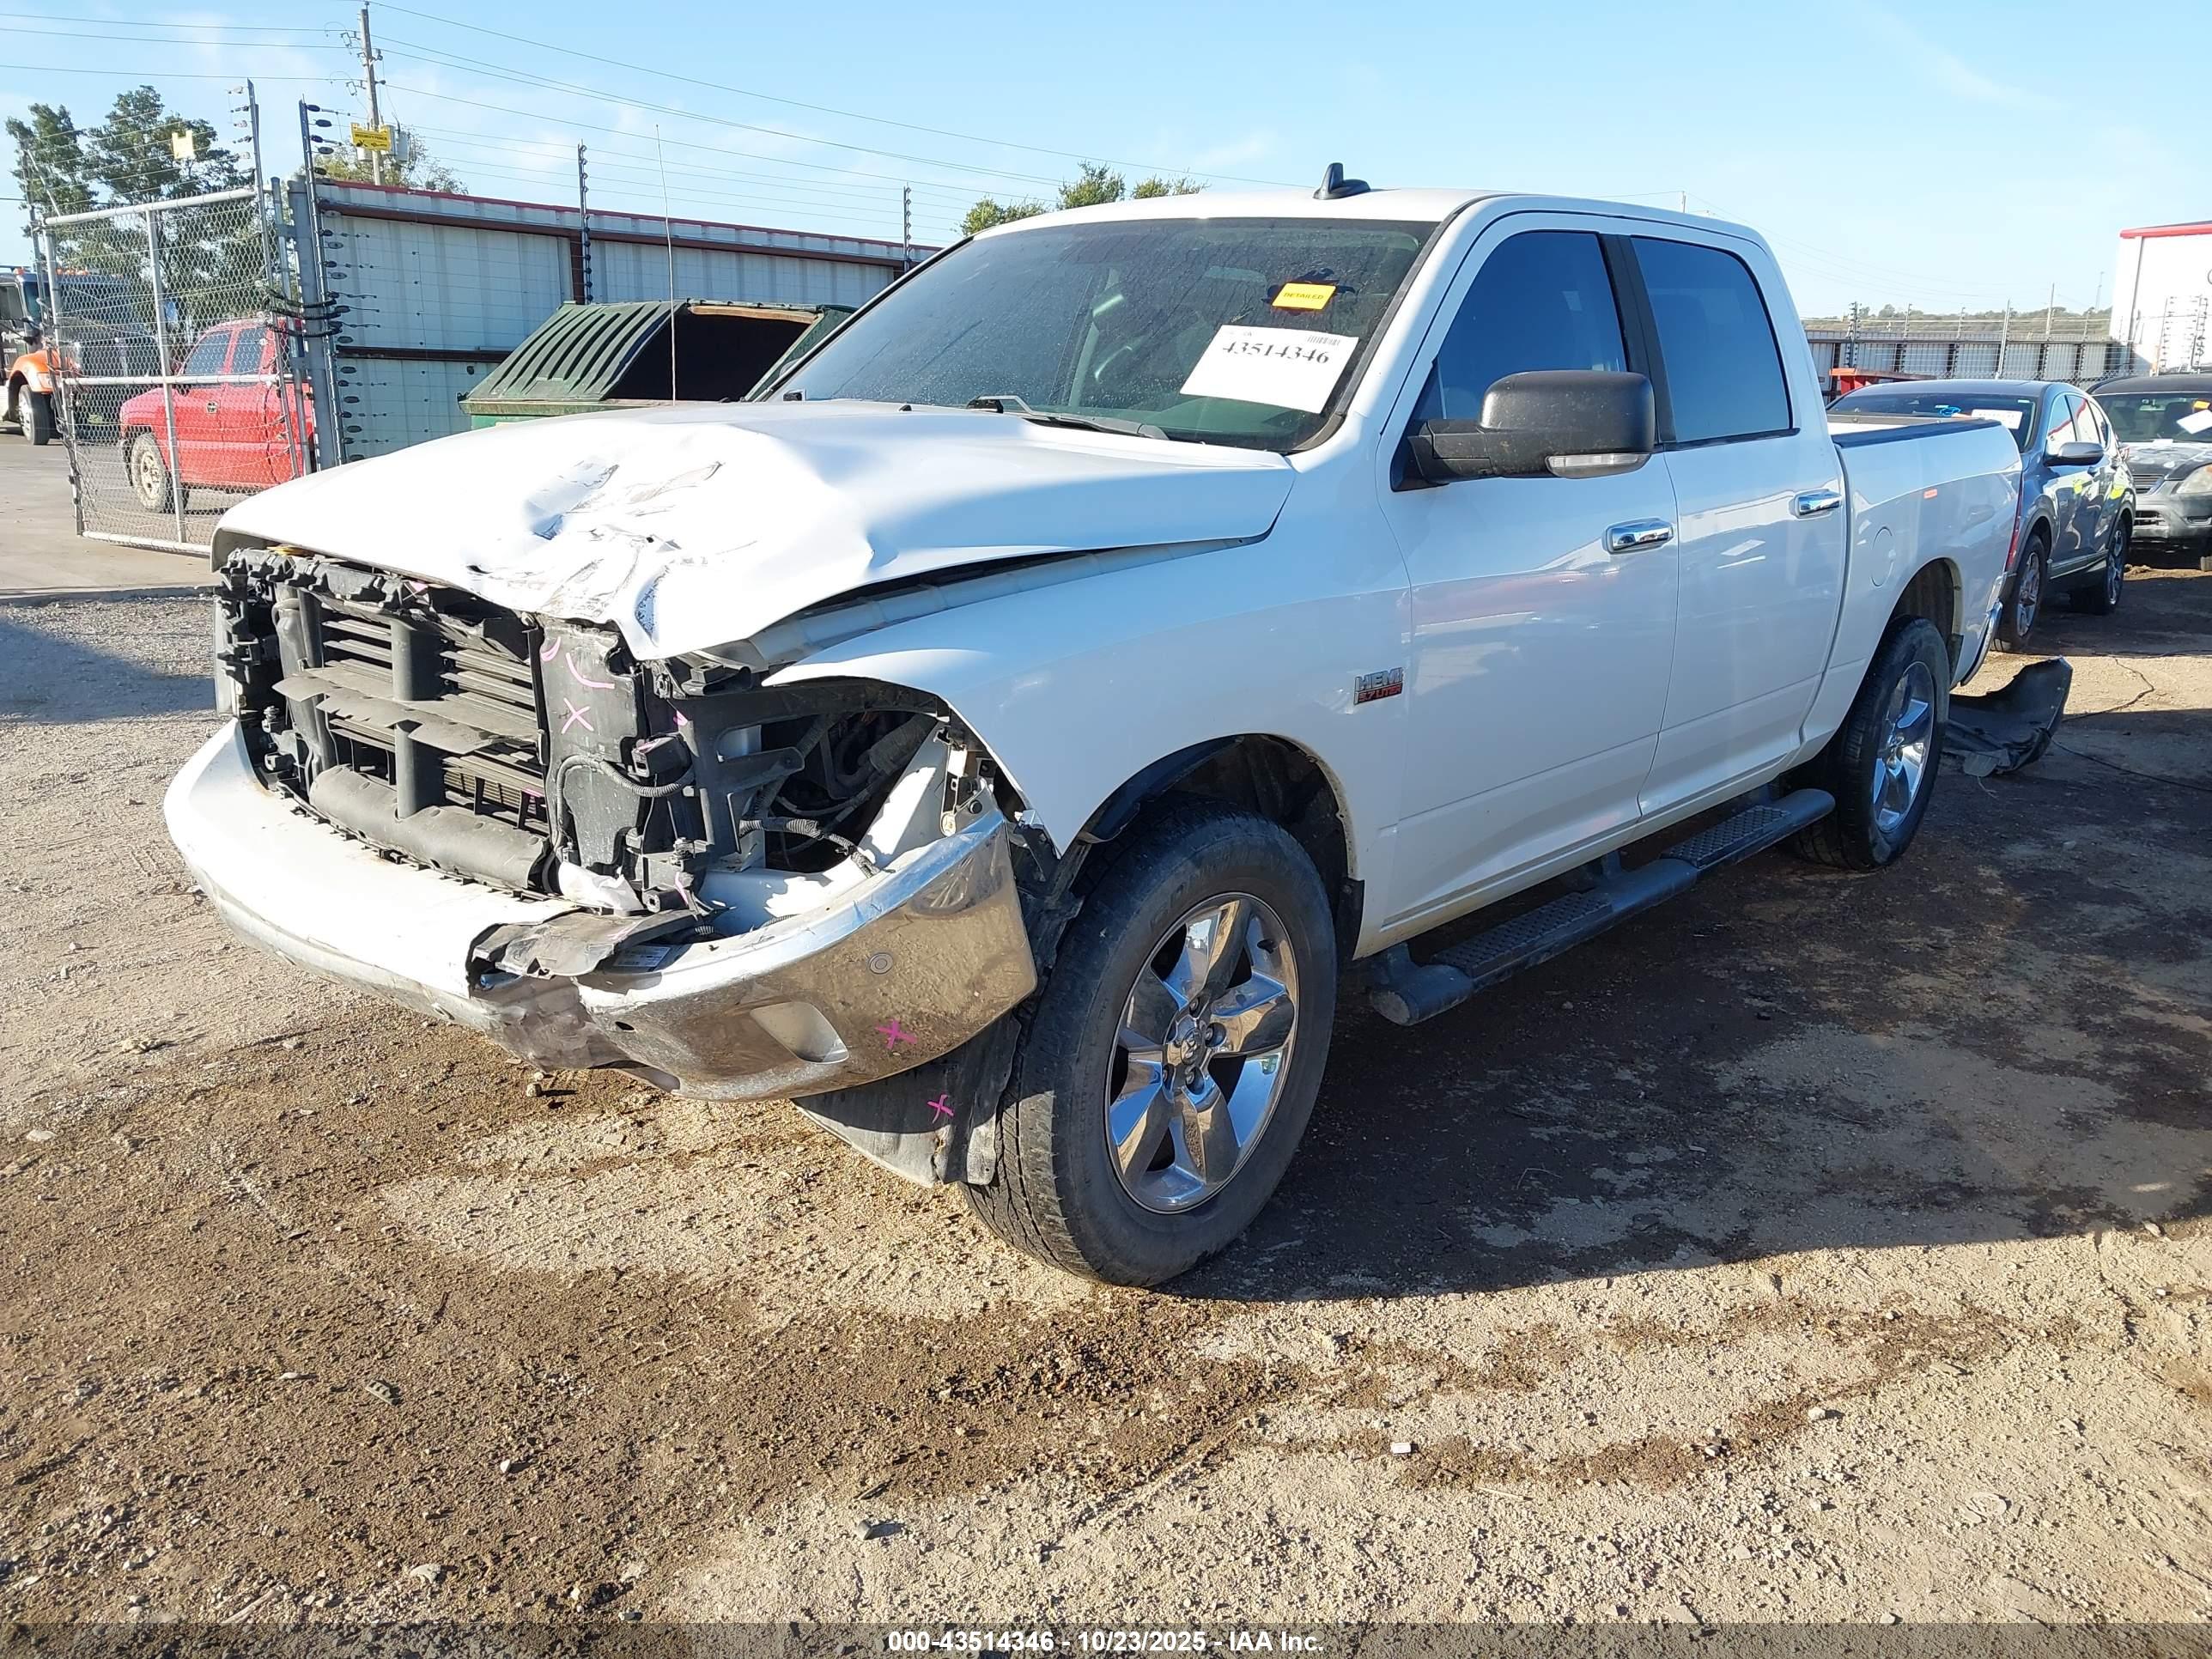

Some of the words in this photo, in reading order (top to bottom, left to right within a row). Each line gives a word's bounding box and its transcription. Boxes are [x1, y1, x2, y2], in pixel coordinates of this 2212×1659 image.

[1222, 341, 1329, 364] 43514346
[1354, 667, 1404, 692] HEMI
[1376, 684, 1402, 698] LITER
